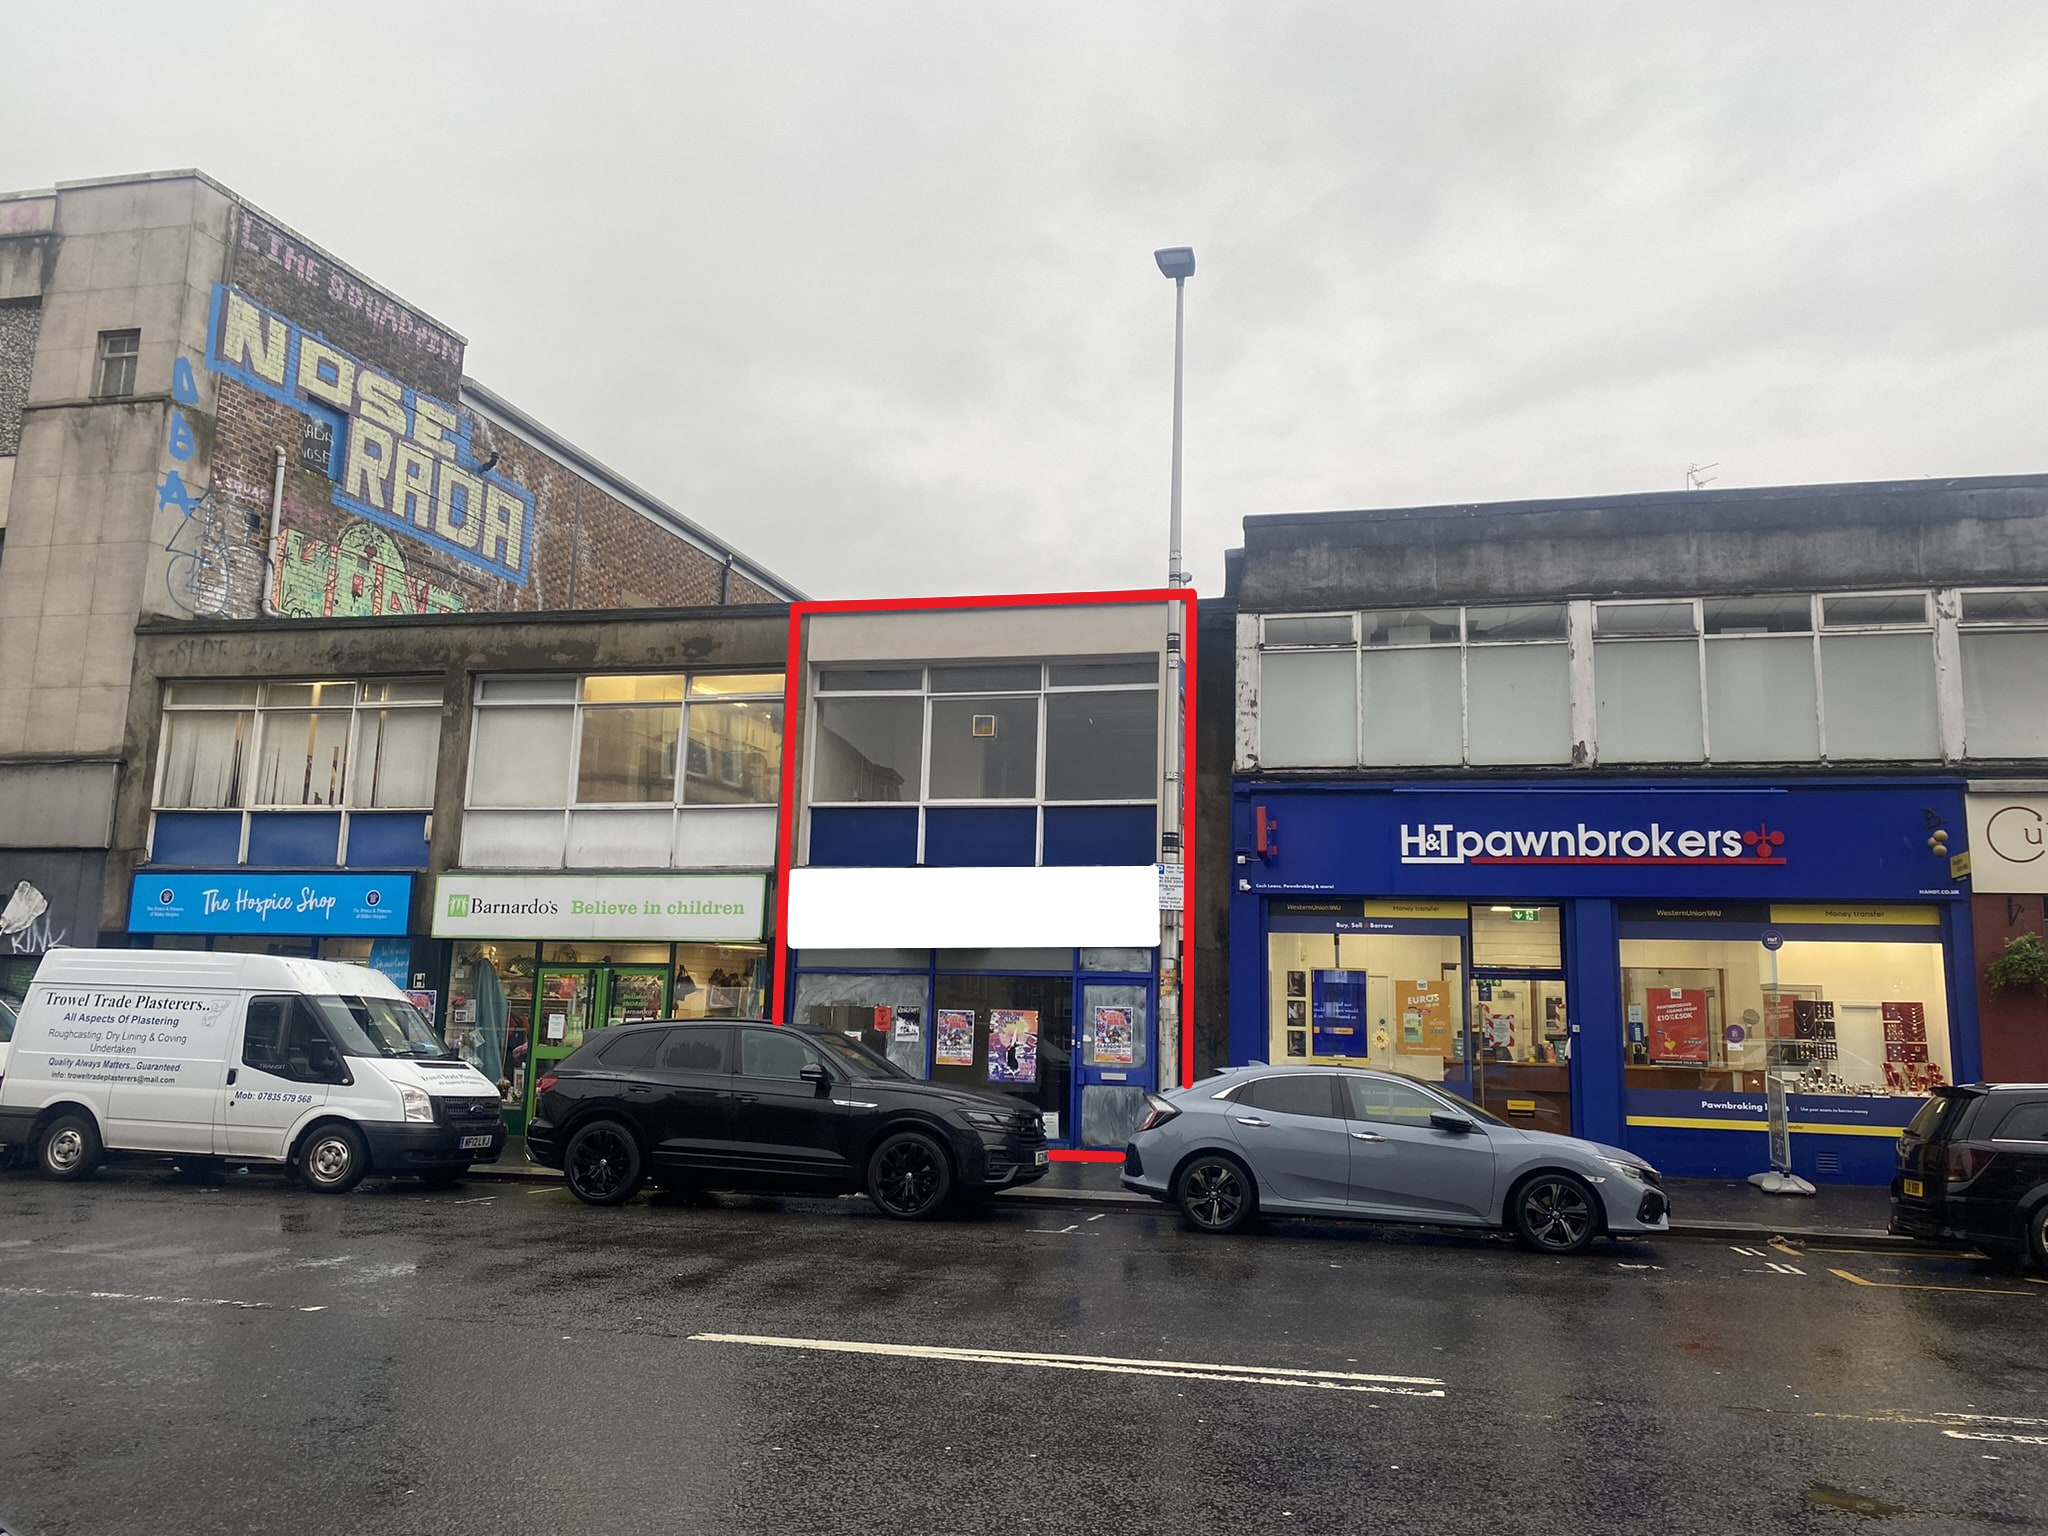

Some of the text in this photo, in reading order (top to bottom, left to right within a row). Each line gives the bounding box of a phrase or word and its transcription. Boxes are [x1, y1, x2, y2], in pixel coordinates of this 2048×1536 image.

[221, 288, 458, 462] NOSE
[342, 414, 526, 572] RADA
[1987, 806, 2048, 863] Cu
[202, 886, 337, 922] The Hospice Shop
[470, 898, 745, 915] Barnardo's Believe in children
[1825, 910, 1885, 919] Money transfer
[1335, 922, 1350, 930] Buy,
[46, 992, 91, 1008] Trowel
[94, 993, 133, 1009] Trade
[1407, 994, 1440, 1005] EUROS
[63, 1012, 180, 1028] All Aspects Of Plastering
[48, 1028, 187, 1045] Roughcasting, Dry Lining & Coving
[90, 1043, 137, 1055] Undertaken
[48, 1057, 74, 1069] Quality
[75, 1058, 101, 1069] Always
[51, 1071, 66, 1079] info:
[234, 1091, 313, 1103] Mob: 07835 579 568
[1701, 1100, 1763, 1113] Pawnbroking
